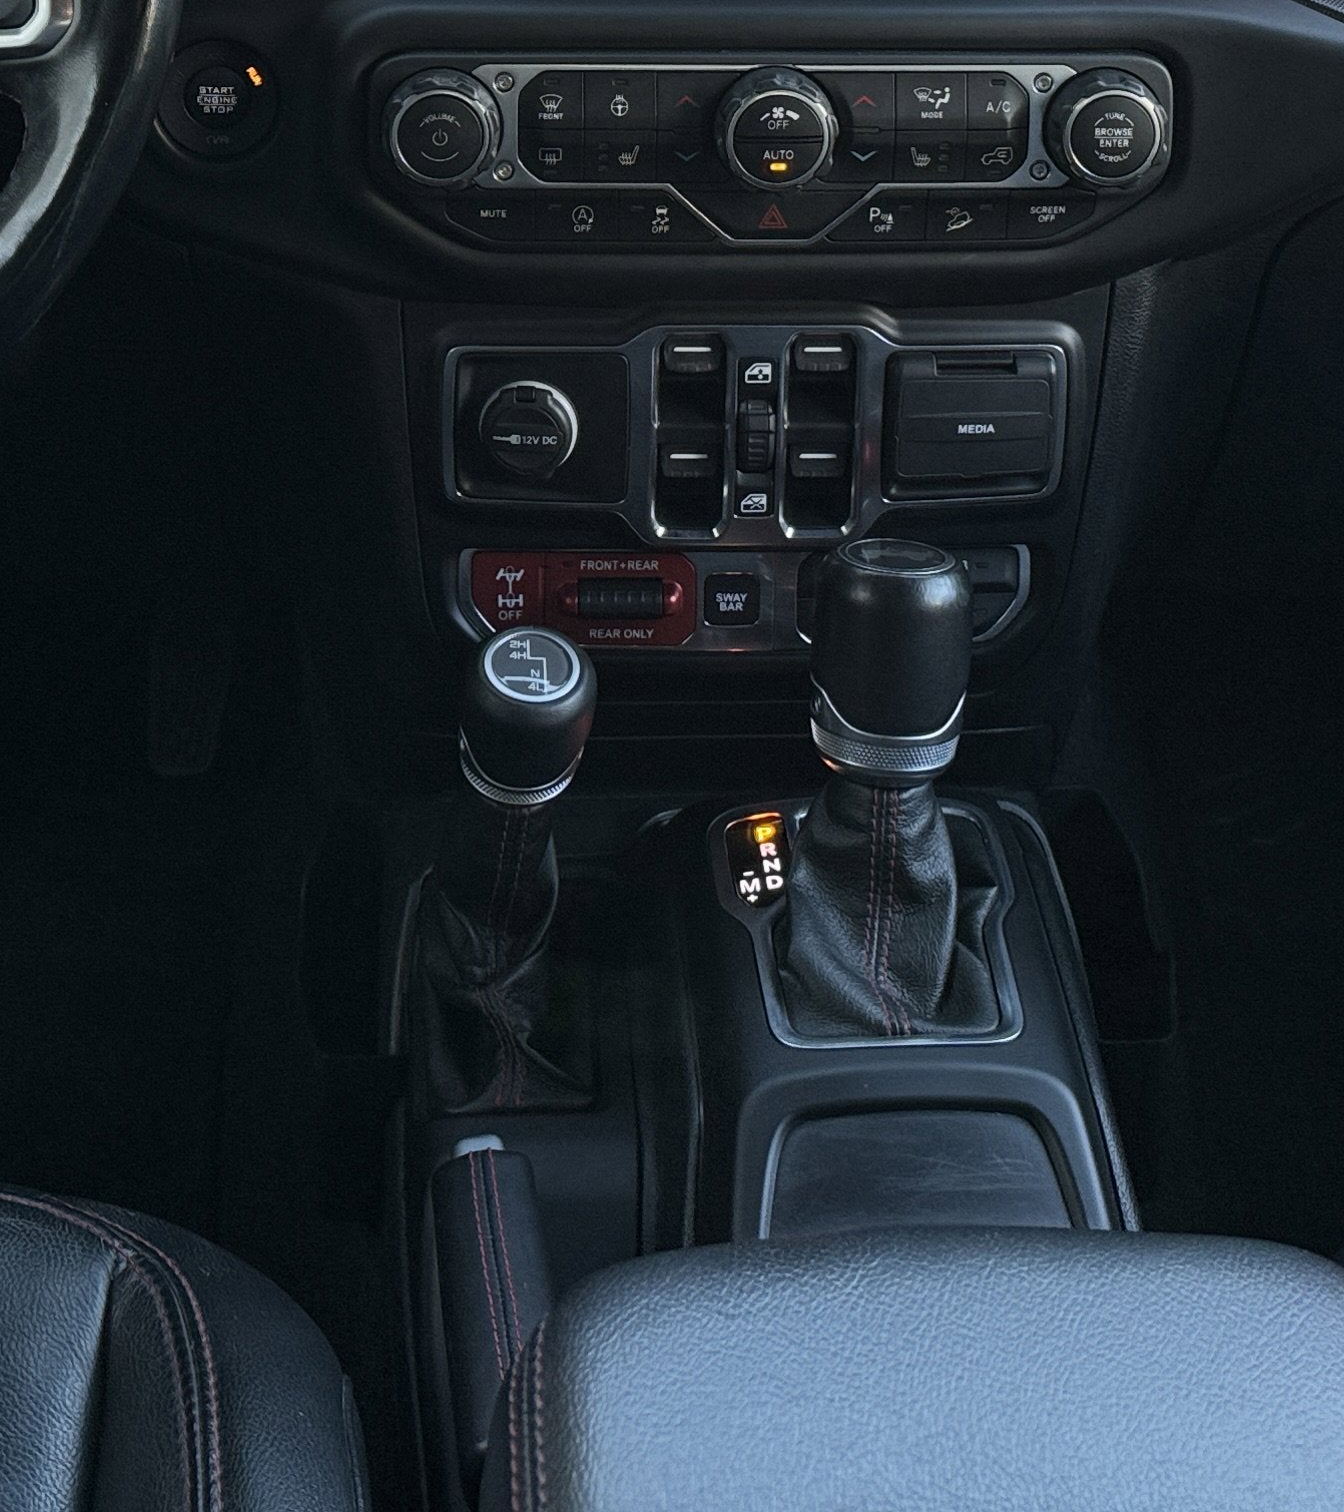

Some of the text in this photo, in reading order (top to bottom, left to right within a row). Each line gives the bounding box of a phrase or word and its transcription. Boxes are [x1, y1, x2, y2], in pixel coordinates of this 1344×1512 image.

[199, 86, 235, 94] START
[197, 96, 238, 104] ENGINE
[203, 106, 234, 114] STOP
[986, 101, 1011, 114] A/C
[422, 112, 457, 124] VOLUME
[921, 111, 943, 119] MODE
[1104, 112, 1126, 121] TUNE
[767, 120, 791, 130] OFF
[1094, 128, 1133, 136] BROWSE
[1099, 139, 1129, 148] ENTER
[763, 150, 794, 160] AUTO
[1098, 152, 1130, 162] SCROLL
[480, 210, 506, 218] MUTE
[1030, 206, 1066, 214] SCREEN
[1038, 215, 1056, 223] OFF
[574, 225, 592, 233] OFF
[652, 225, 670, 233] OFF
[874, 225, 892, 233] OFF
[958, 423, 995, 434] MEDIA
[521, 435, 557, 445] 12V DC
[715, 592, 748, 603] SWAY
[719, 602, 744, 612] BAR
[498, 610, 523, 621] OFF
[589, 629, 655, 639] REAR ONLY
[509, 640, 526, 648] 2H
[509, 651, 526, 659] 4H
[530, 669, 540, 678] N
[527, 682, 544, 691] 4L
[755, 825, 776, 843] P
[759, 842, 777, 857] R
[763, 858, 781, 873] N
[739, 877, 761, 894] M
[766, 875, 783, 890] D
